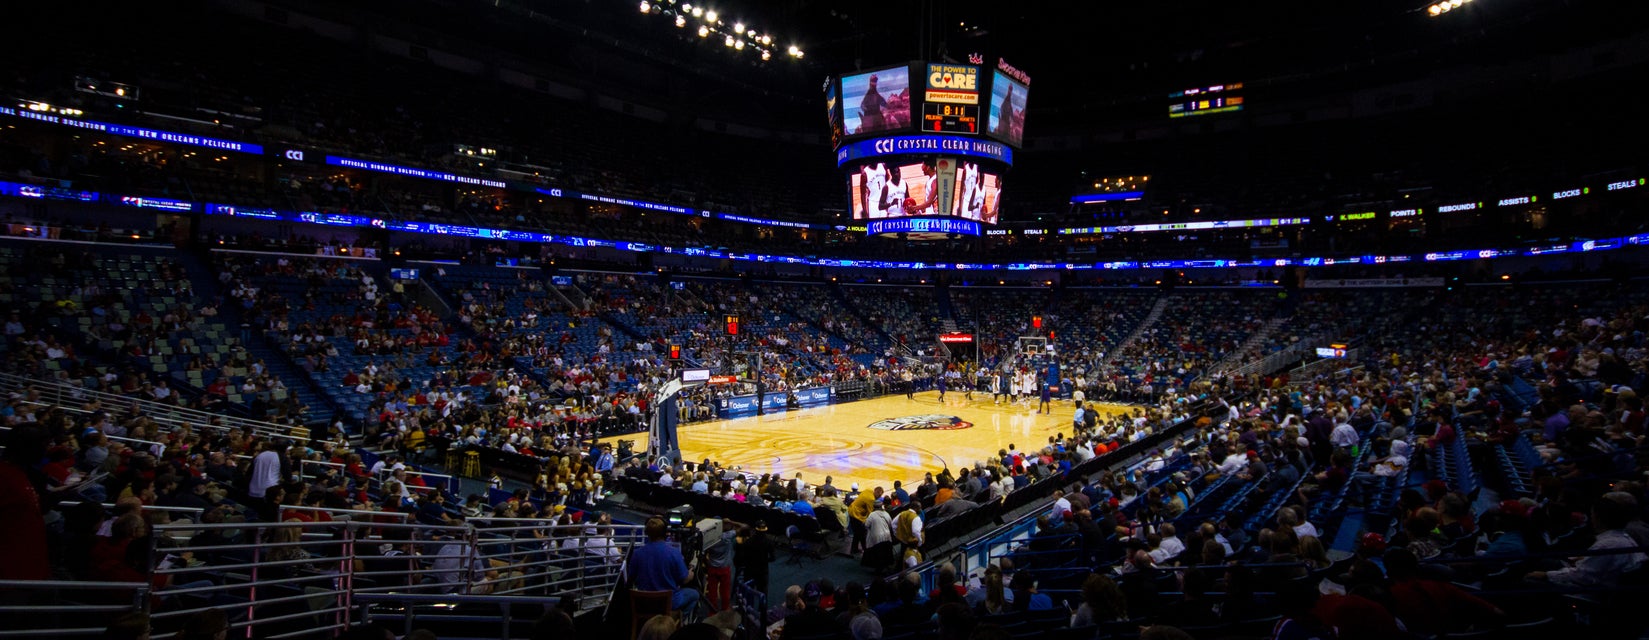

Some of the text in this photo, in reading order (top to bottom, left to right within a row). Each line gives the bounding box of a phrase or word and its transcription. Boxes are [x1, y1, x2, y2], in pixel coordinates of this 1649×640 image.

[930, 72, 976, 89] CARE
[929, 92, 975, 100] powertocare.com
[944, 105, 964, 115] 8:11
[139, 130, 157, 138] NEW
[162, 133, 199, 144] ORLEANS
[203, 138, 242, 151] PELICANS
[875, 138, 1002, 156] CCI CRYSTAL CLEAR IMAGING
[286, 150, 303, 160] CCI
[458, 176, 480, 184] ORLEANS
[482, 180, 506, 188] PELICANS
[1608, 180, 1636, 191] STEALS
[551, 188, 562, 197] CCI
[1553, 189, 1580, 199] BLOCKS
[1498, 197, 1529, 206] ASSISTS
[1390, 209, 1416, 217] POINTS
[1438, 203, 1476, 213] REBOUNDS
[1348, 212, 1375, 220] WALKER
[873, 222, 883, 232] CCI
[885, 221, 914, 230] CRYSTAL
[917, 220, 940, 230] CLEAR
